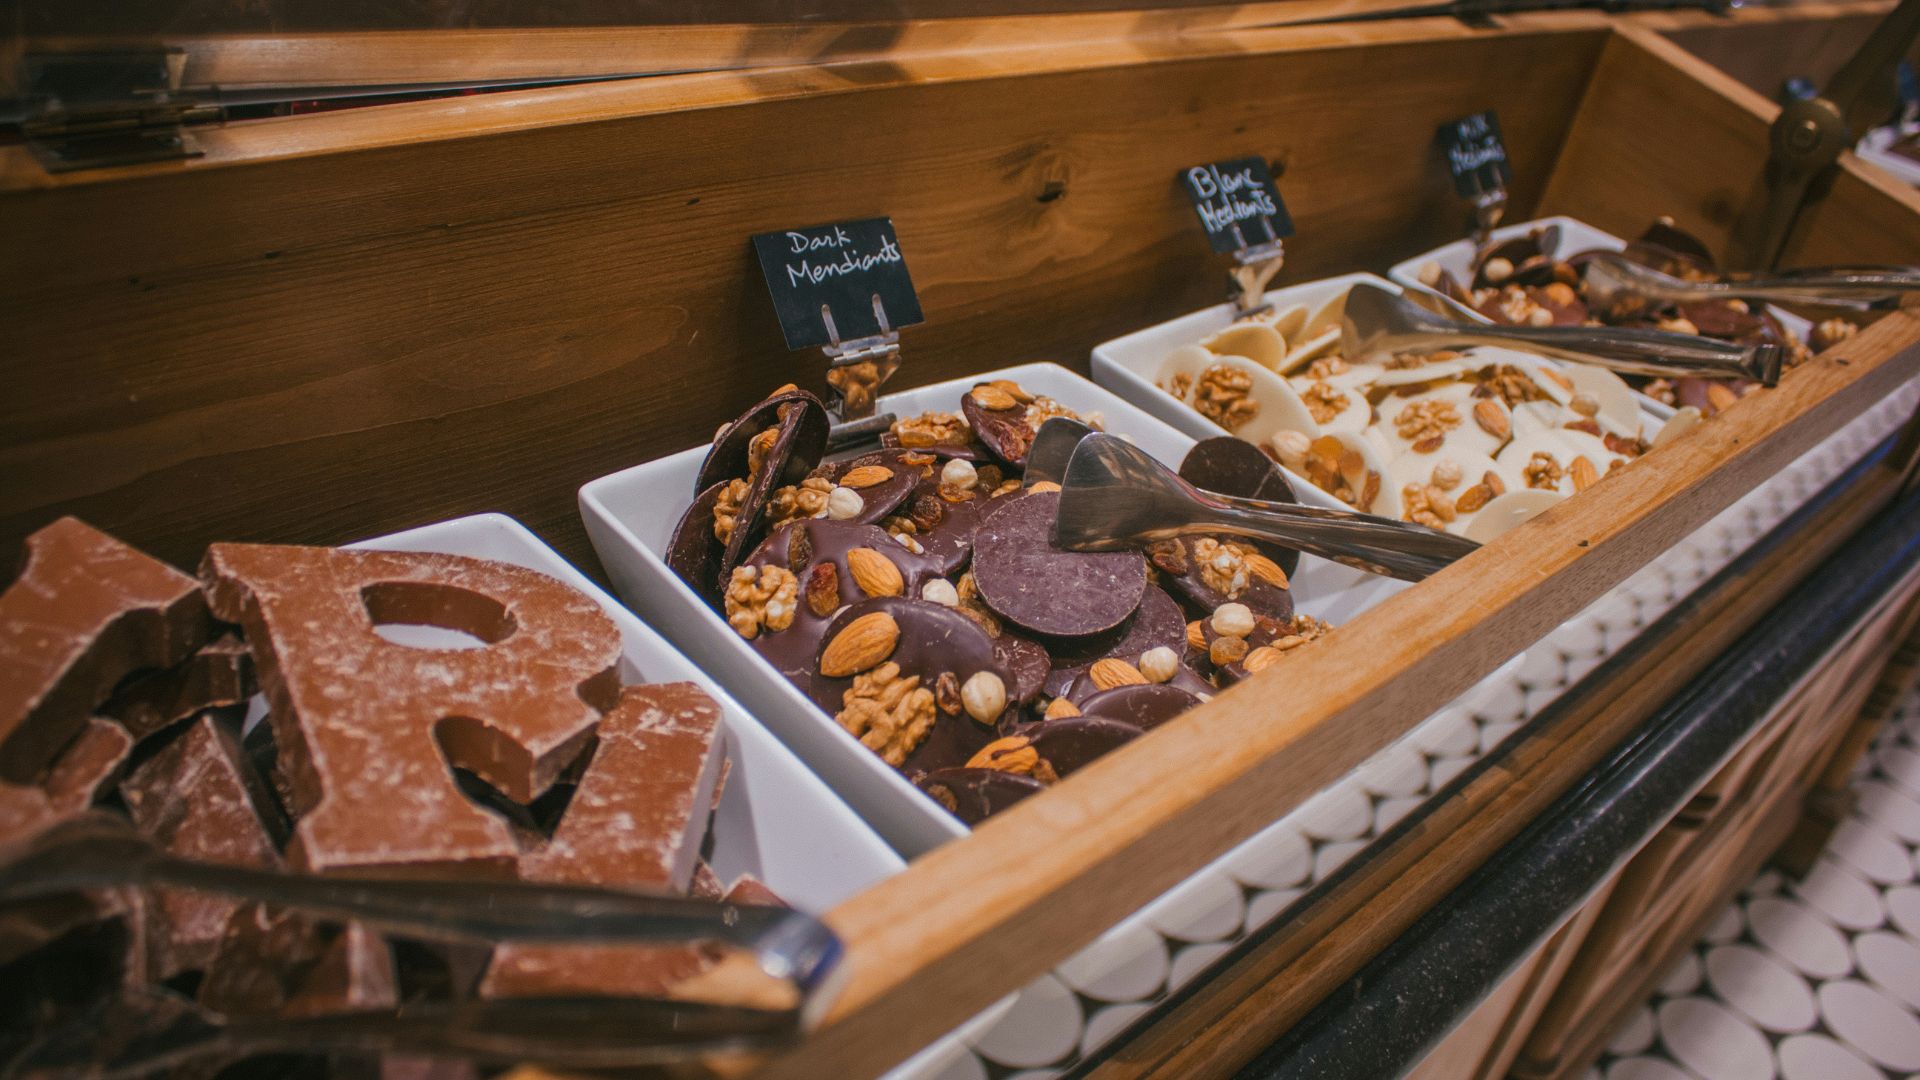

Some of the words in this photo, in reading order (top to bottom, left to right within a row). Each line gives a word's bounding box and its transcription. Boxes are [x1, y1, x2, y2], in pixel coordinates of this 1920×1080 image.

[1188, 164, 1264, 198] Blanc
[786, 226, 851, 253] Dark
[786, 235, 902, 287] Mendiants
